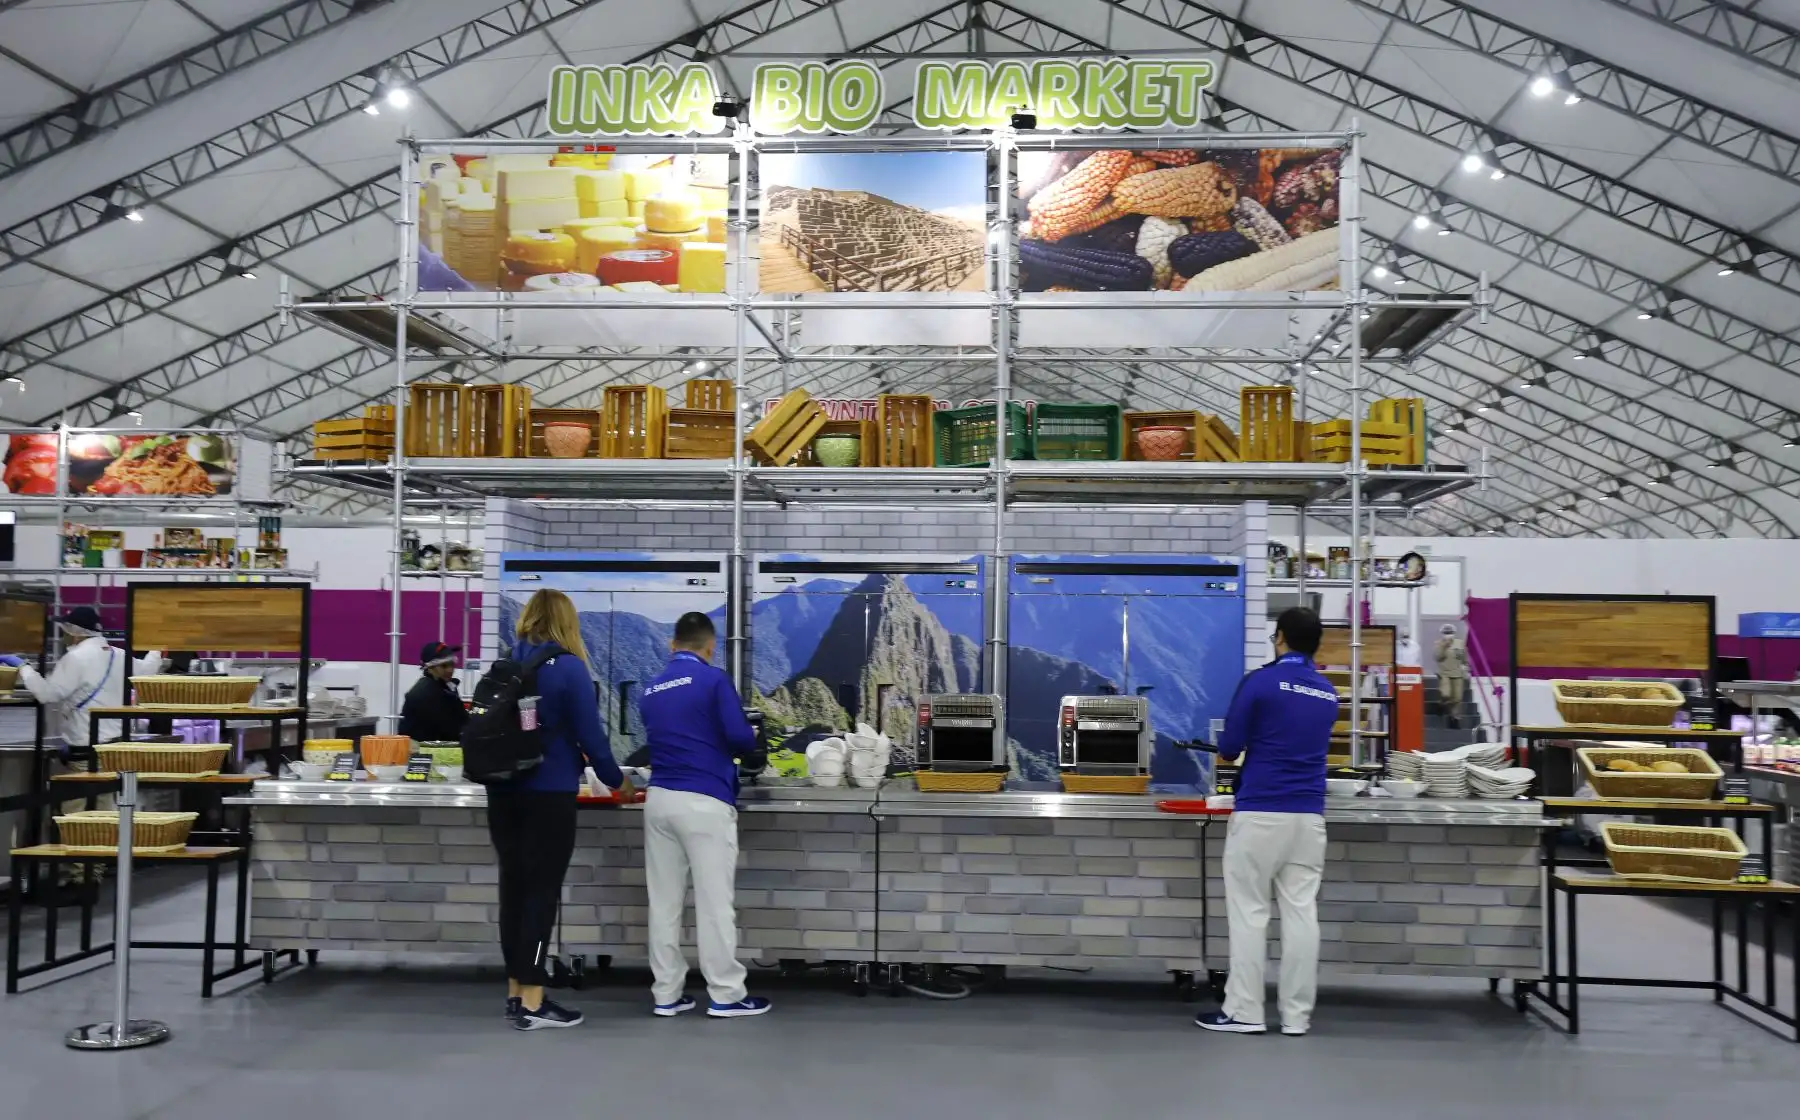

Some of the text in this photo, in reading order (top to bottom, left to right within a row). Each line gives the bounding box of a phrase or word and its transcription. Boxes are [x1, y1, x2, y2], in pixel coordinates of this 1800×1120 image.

[549, 60, 1215, 134] INKA BIO MARKET
